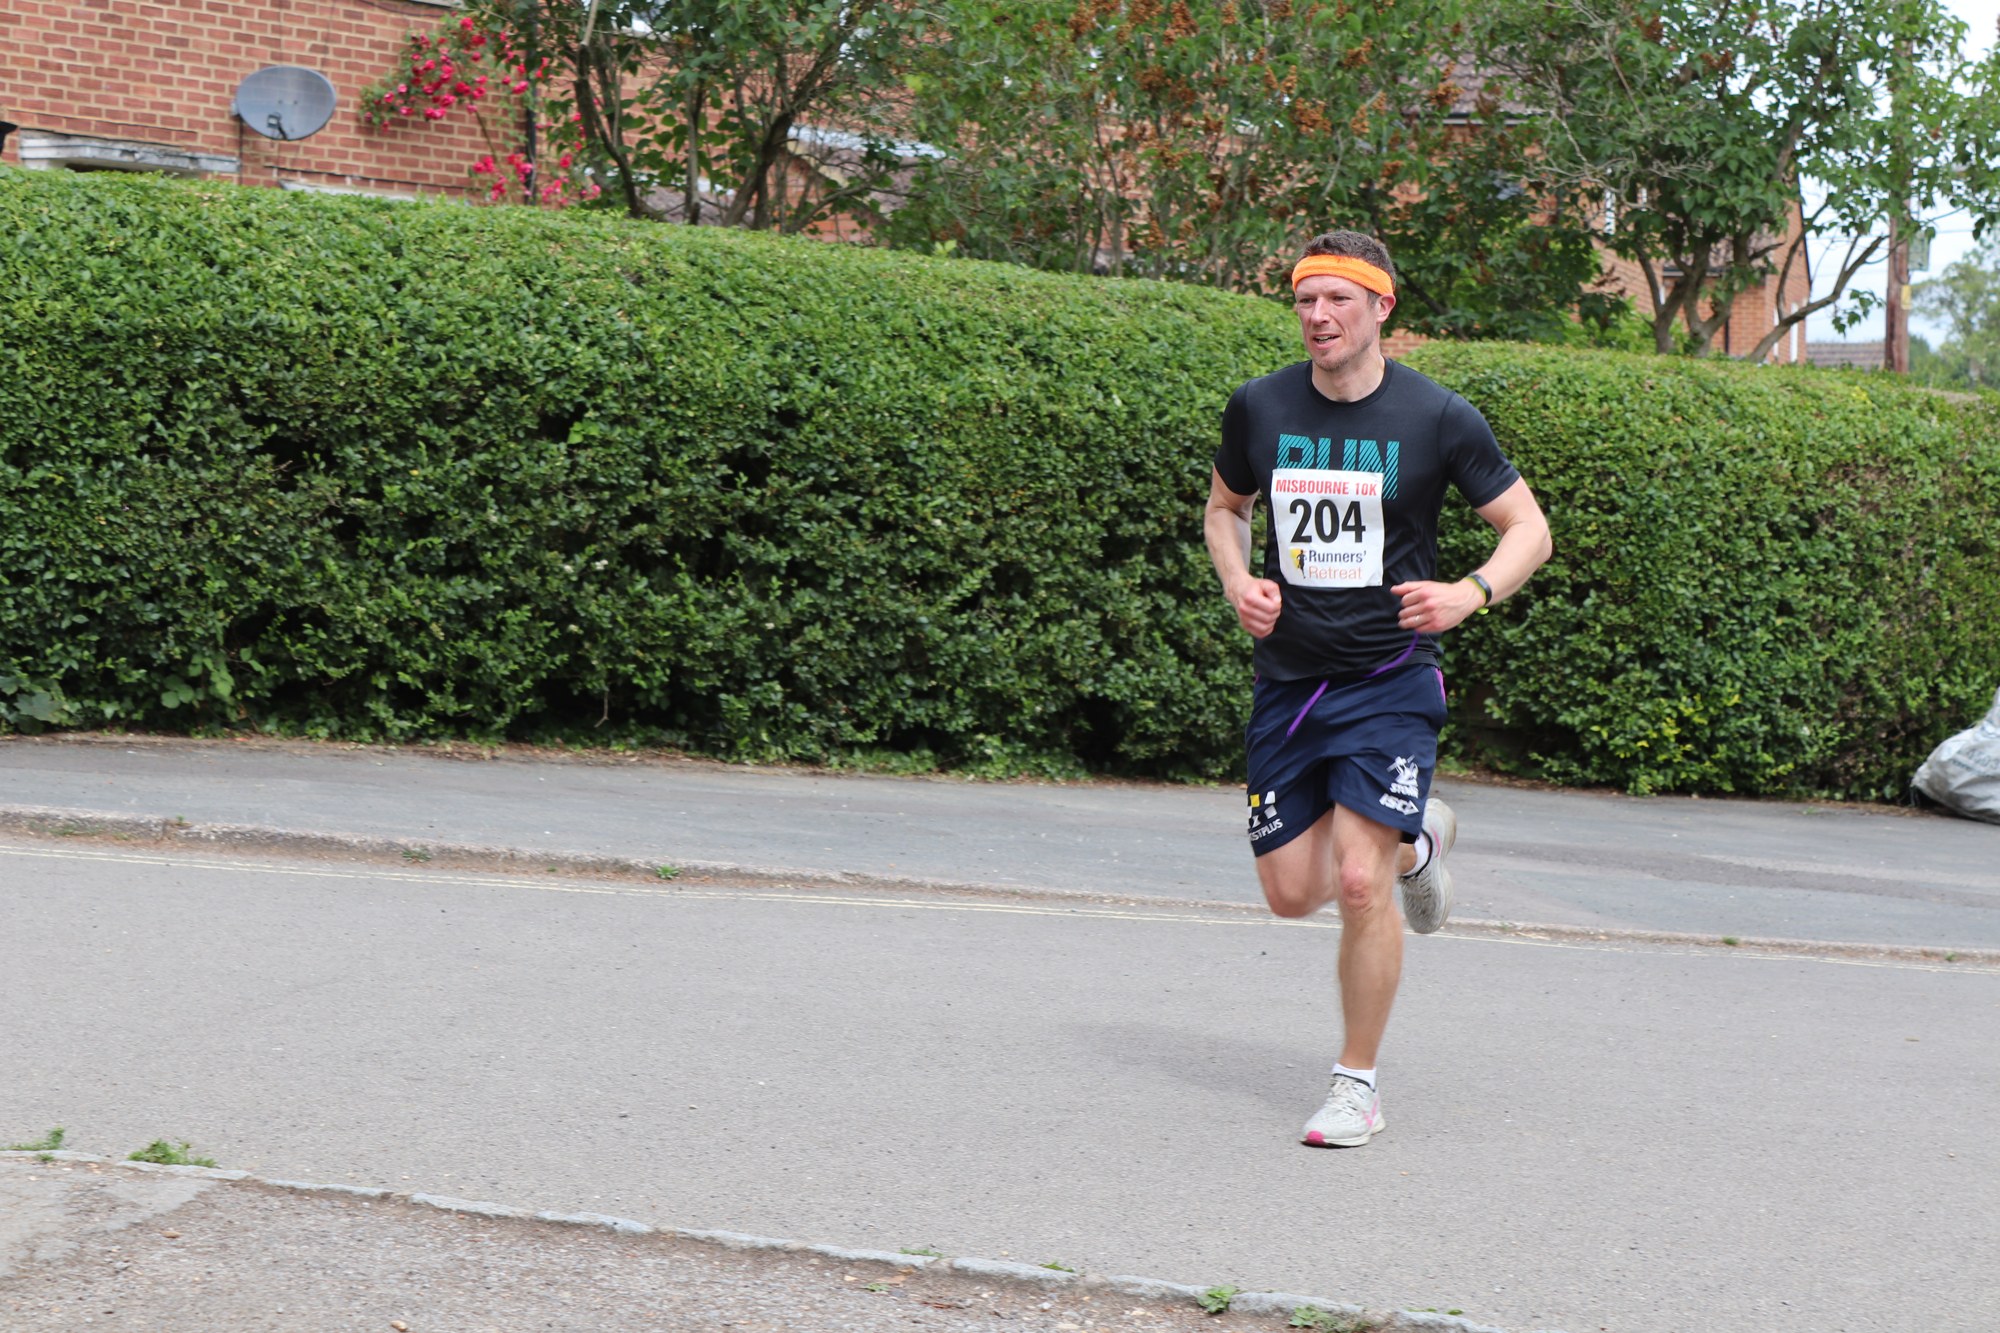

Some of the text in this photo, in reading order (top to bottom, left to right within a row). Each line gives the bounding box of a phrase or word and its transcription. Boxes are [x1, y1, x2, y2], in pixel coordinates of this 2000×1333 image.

[1275, 480, 1377, 496] MISBOURNE 10K
[1289, 498, 1366, 544] 204
[1308, 549, 1367, 563] Runners'
[1308, 565, 1363, 580] Retreat
[1249, 818, 1284, 842] STPLUS
